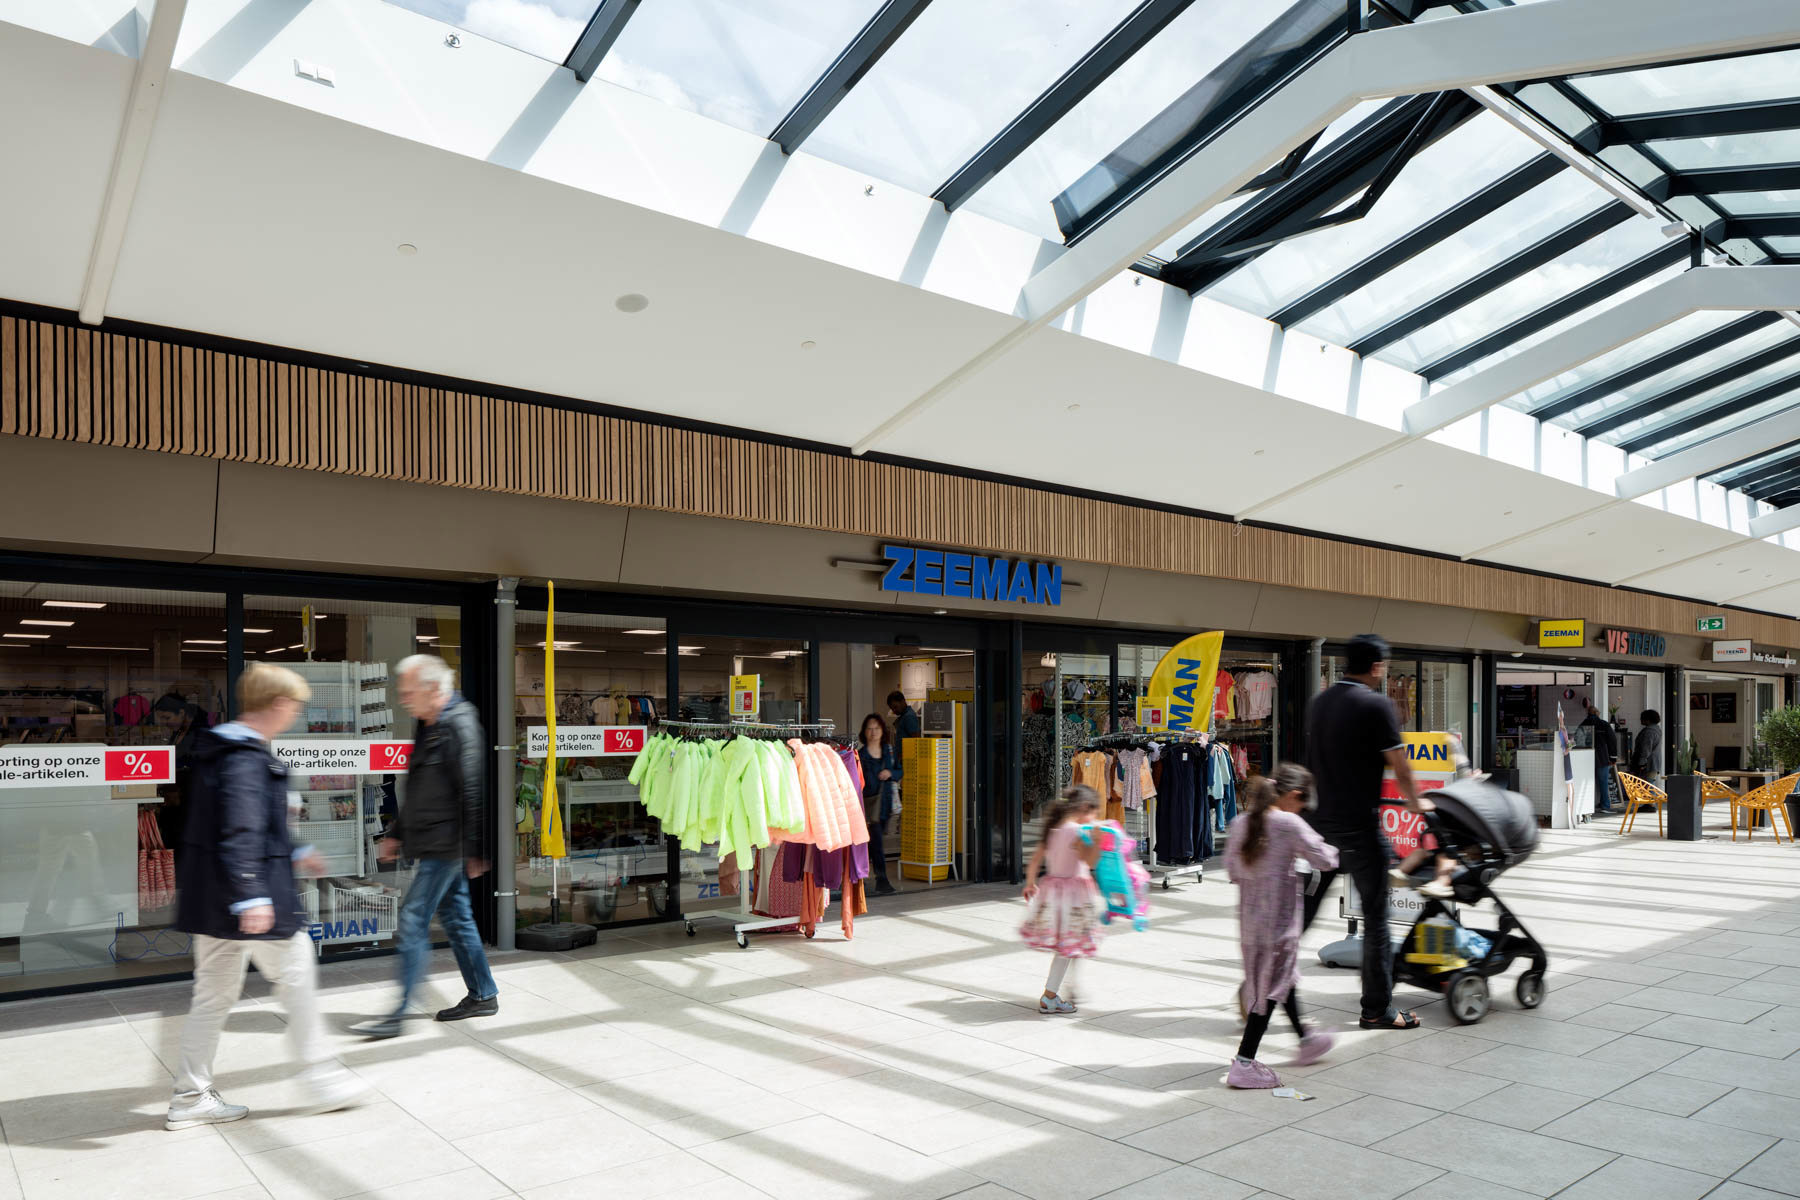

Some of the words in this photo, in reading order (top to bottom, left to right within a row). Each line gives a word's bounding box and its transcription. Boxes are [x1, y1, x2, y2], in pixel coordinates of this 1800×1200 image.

[880, 545, 1062, 606] ZEEMAN
[1543, 629, 1580, 637] ZEEMAN
[1607, 629, 1666, 657] VISTREND
[567, 733, 579, 742] op
[580, 733, 602, 741] onze
[615, 731, 634, 749] %
[277, 747, 320, 759] Korting
[322, 749, 337, 758] op
[340, 749, 367, 757] onze
[384, 746, 407, 766] %
[531, 743, 595, 752] saleartikelen.
[44, 757, 63, 768] op
[66, 756, 101, 766] onze
[124, 753, 153, 775] %
[1379, 808, 1429, 834] 0%
